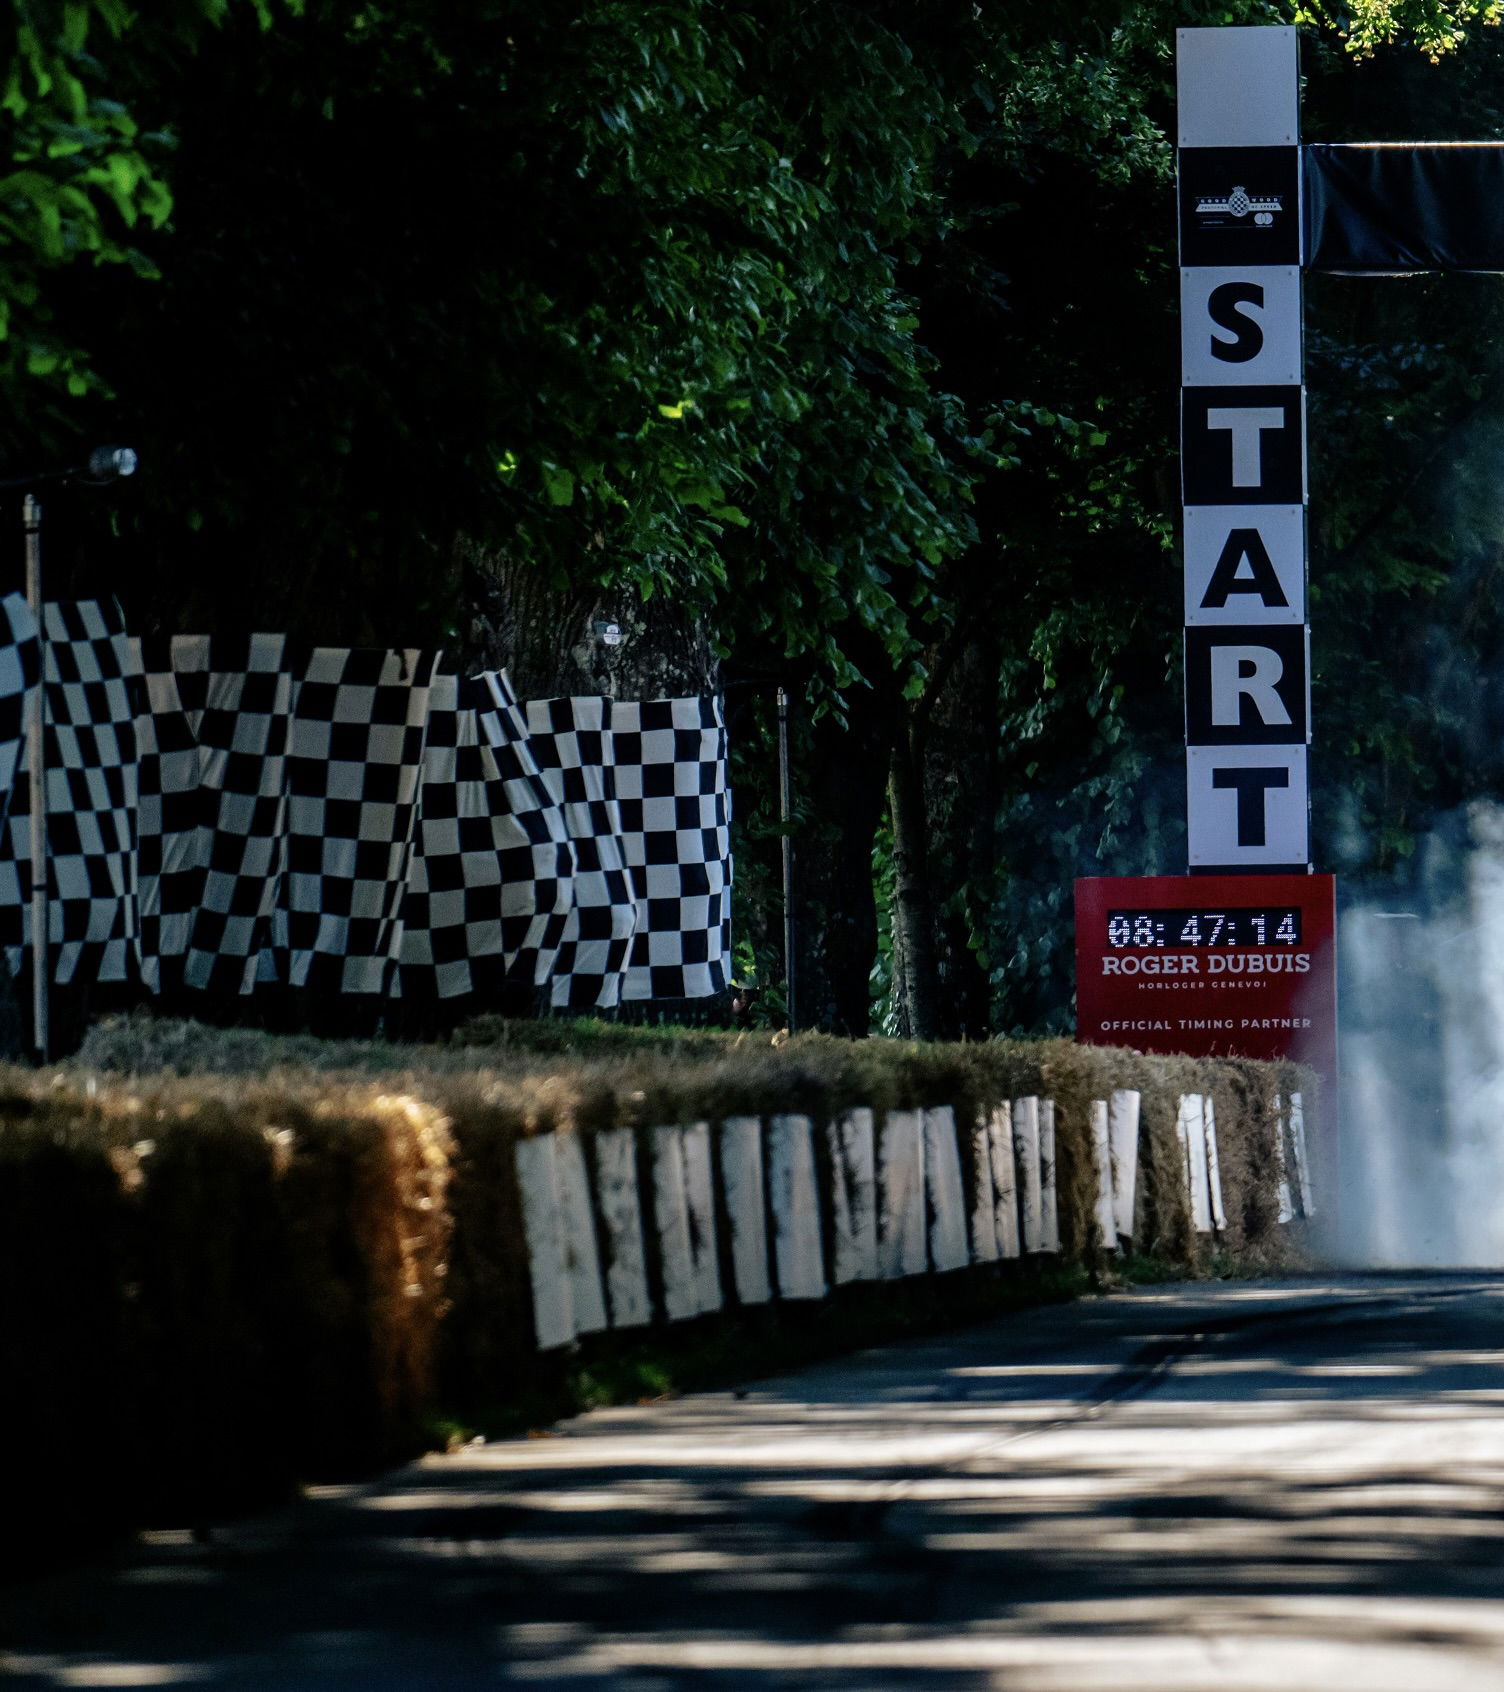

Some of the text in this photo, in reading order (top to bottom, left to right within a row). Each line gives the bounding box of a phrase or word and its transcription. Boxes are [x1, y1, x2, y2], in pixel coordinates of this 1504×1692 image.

[1200, 281, 1293, 847] START
[1102, 954, 1311, 975] ROGER DUBUIS
[1138, 981, 1205, 989] HORLOGER
[1100, 1017, 1312, 1031] OFFICIAL TIMING PARTNER
